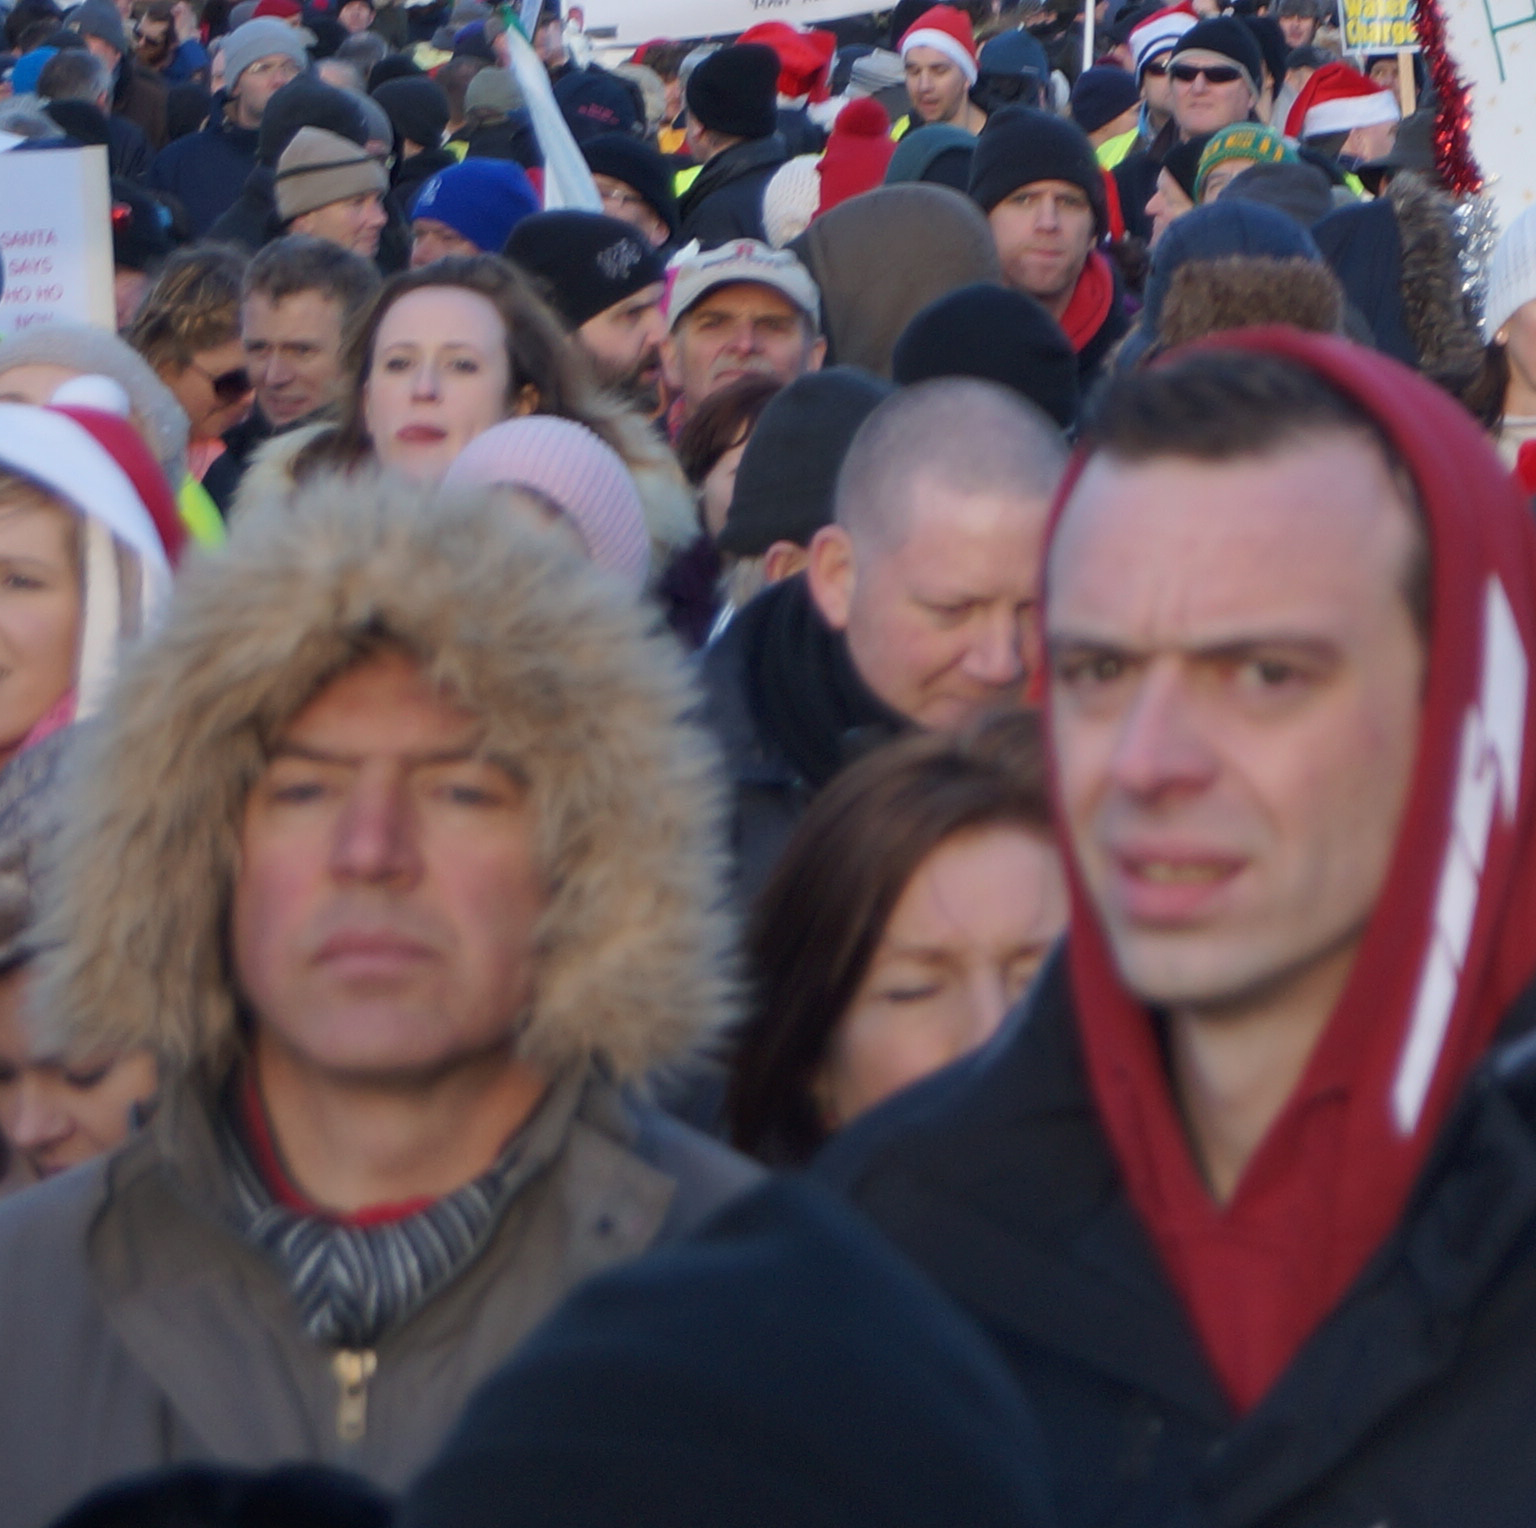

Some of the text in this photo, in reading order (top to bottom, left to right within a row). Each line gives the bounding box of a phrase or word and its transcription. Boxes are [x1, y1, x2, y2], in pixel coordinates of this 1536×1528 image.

[1345, 20, 1420, 45] Charge
[7, 256, 54, 276] SAYS
[3, 283, 64, 304] HO HO
